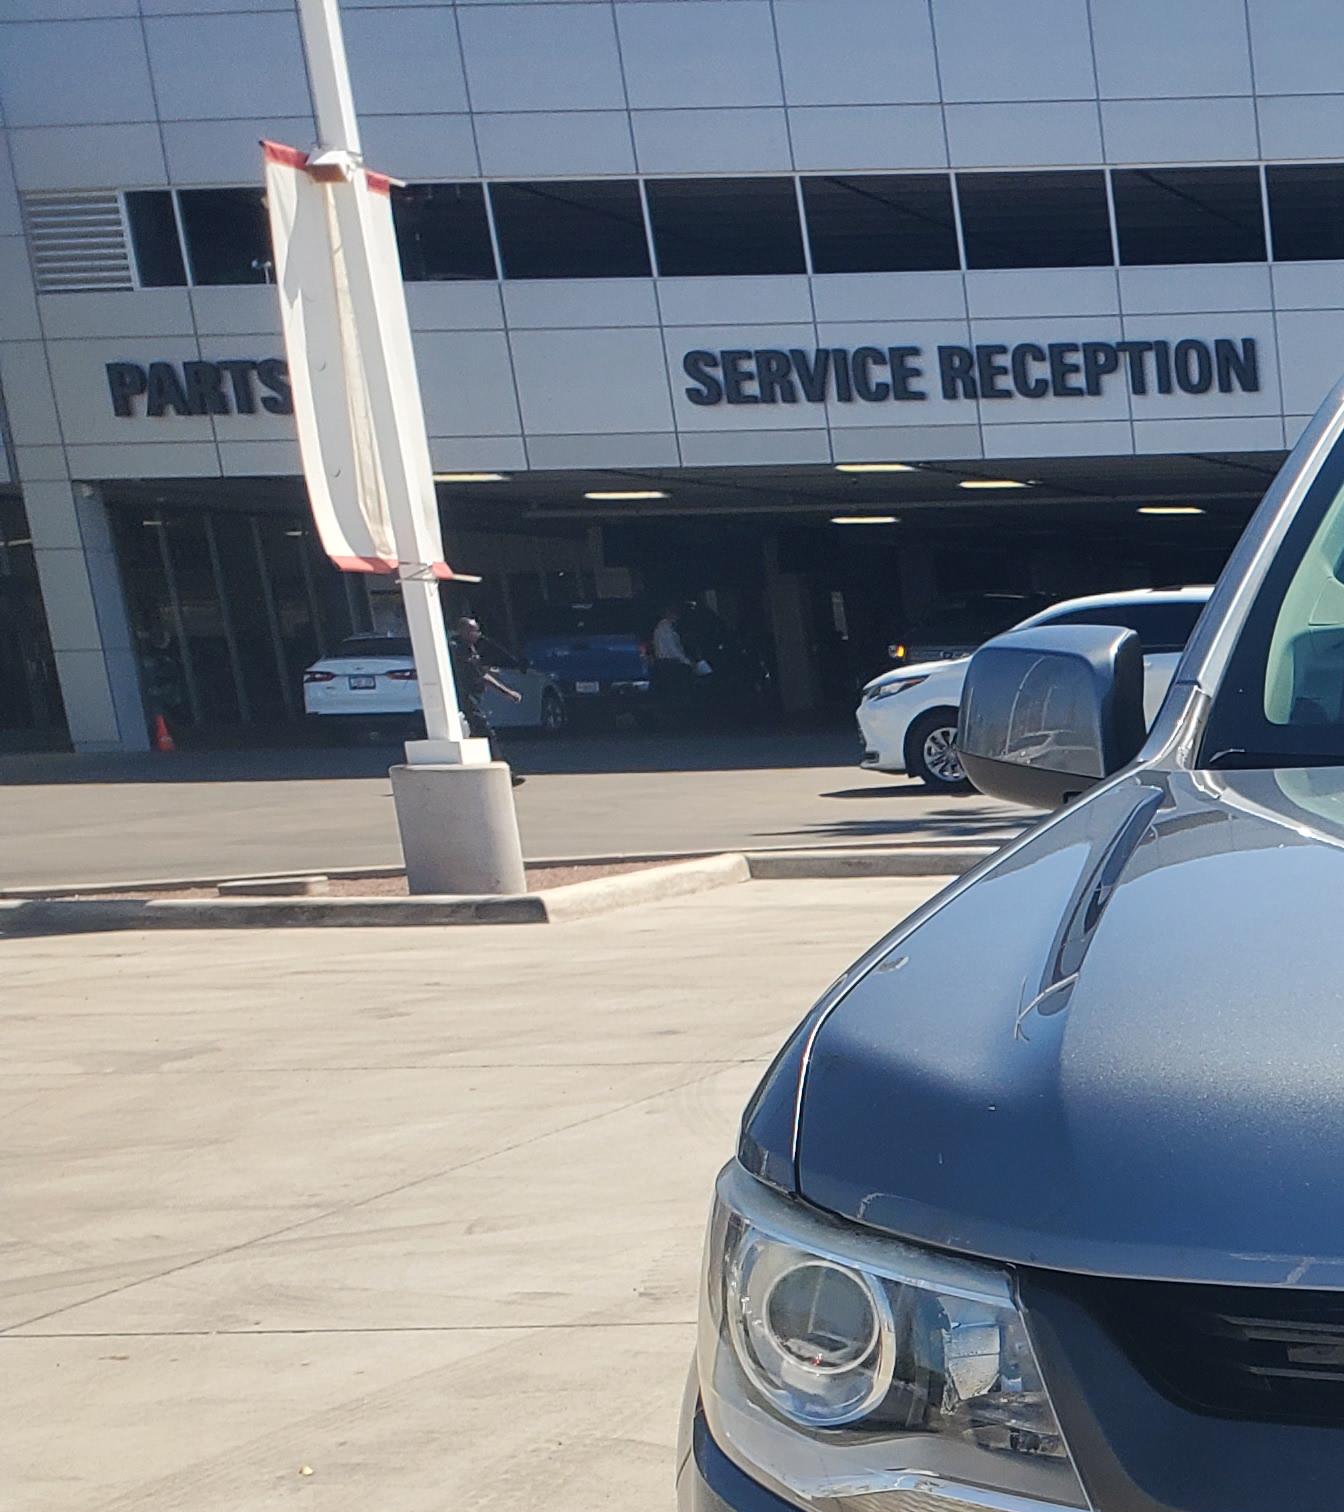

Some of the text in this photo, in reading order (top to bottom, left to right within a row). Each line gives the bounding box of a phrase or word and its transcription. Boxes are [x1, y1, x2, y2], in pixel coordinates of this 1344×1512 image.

[105, 358, 294, 417] PARTS
[682, 338, 1260, 406] SERVICE RECEPTION
